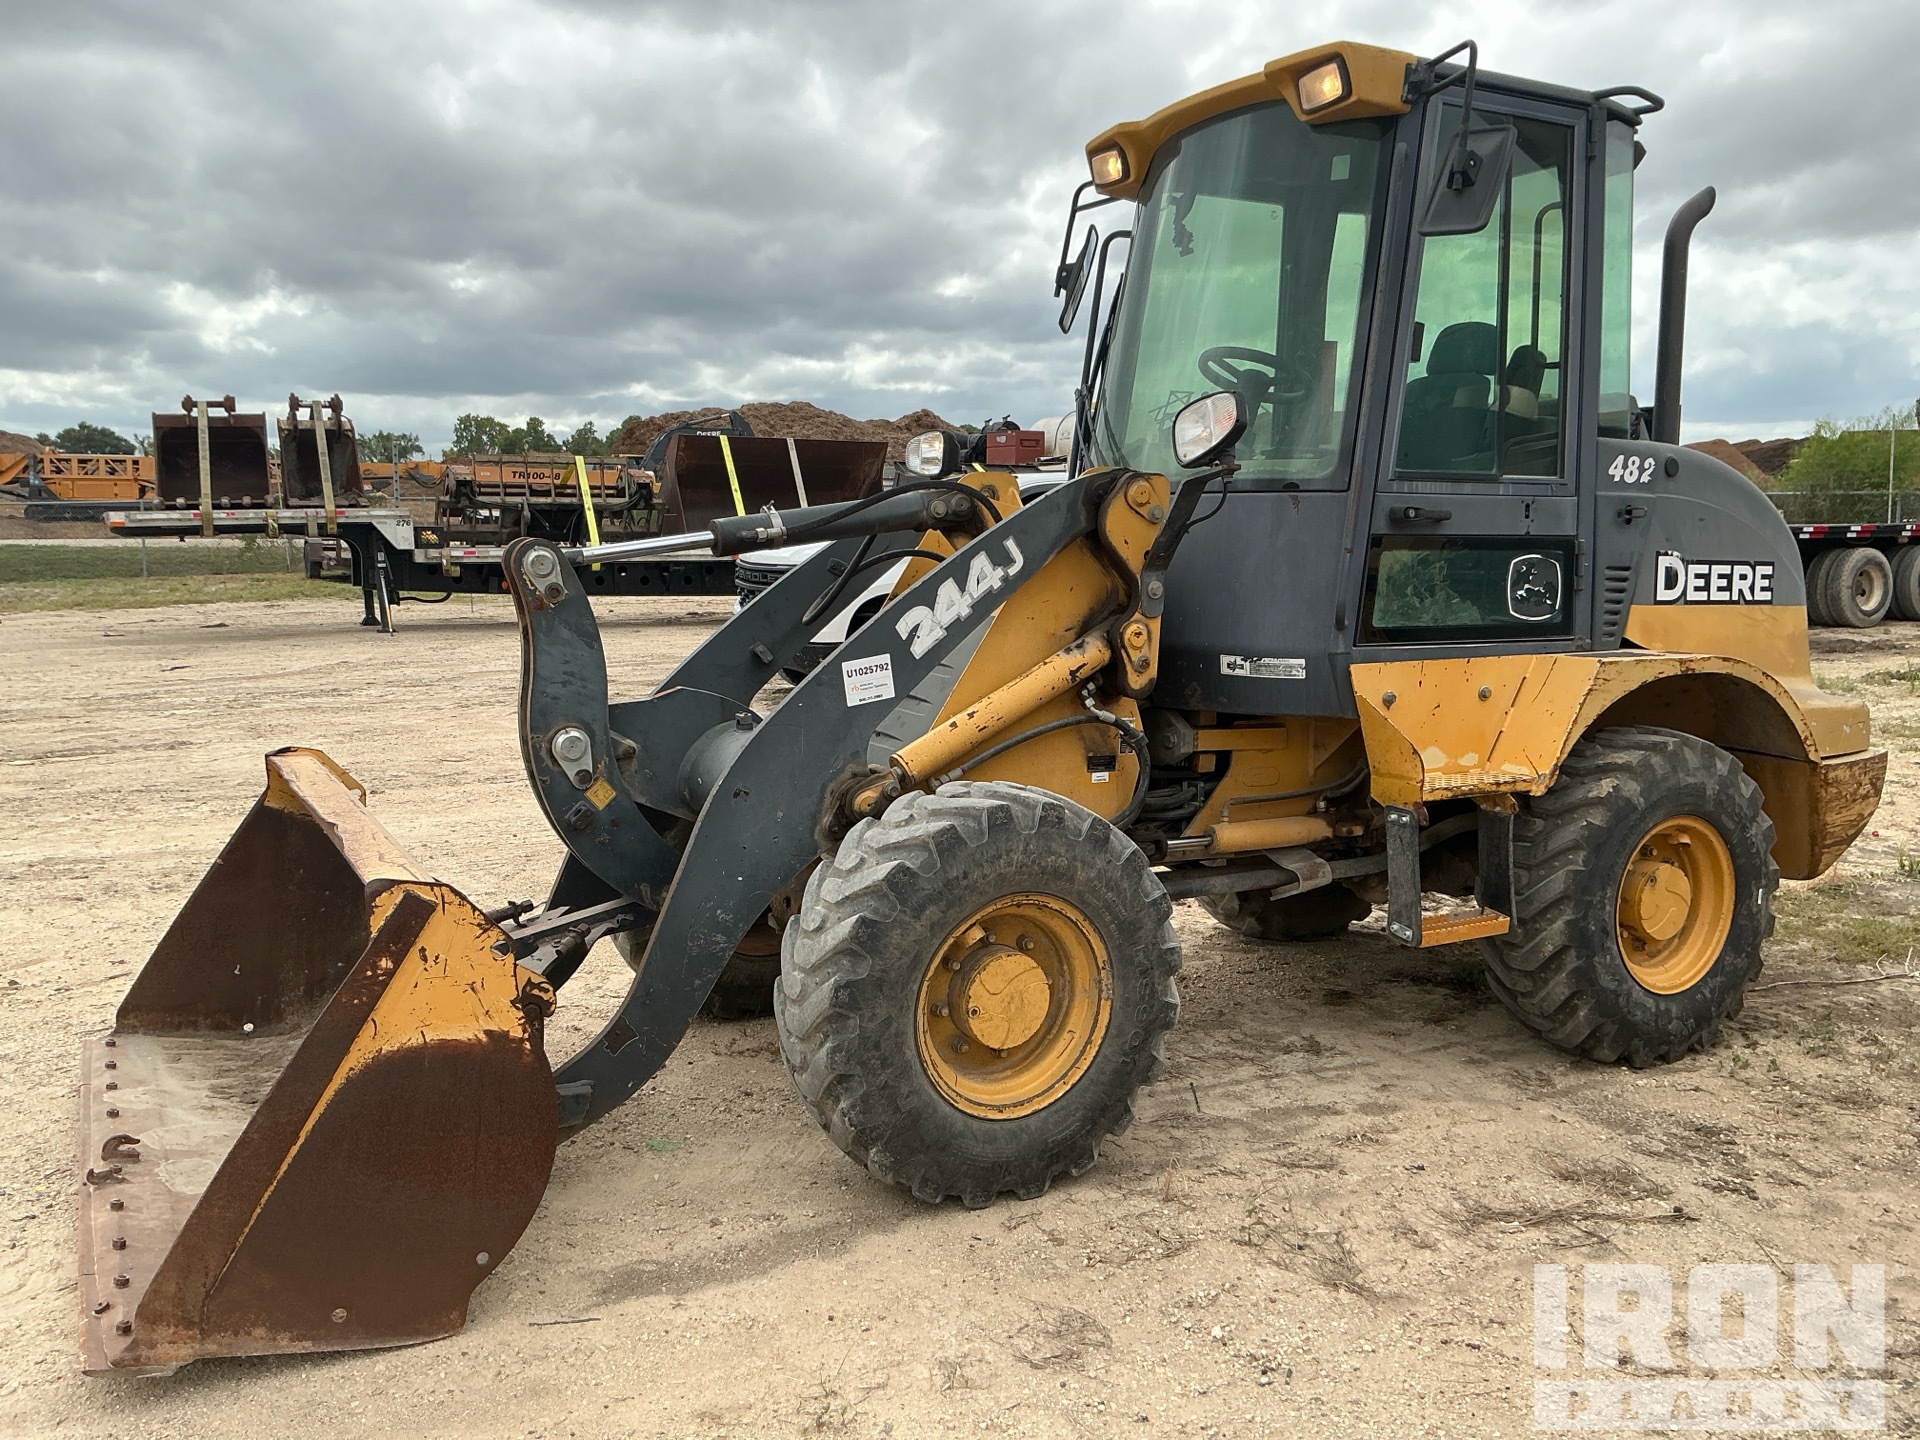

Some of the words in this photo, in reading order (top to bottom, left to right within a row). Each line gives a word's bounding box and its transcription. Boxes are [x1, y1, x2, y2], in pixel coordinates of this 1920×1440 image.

[511, 470, 561, 481] TR100-8
[1608, 454, 1656, 483] 482
[395, 519, 412, 527] 276
[1654, 552, 1775, 603] DEERE
[894, 534, 1024, 660] 244J
[846, 662, 890, 679] U1025792
